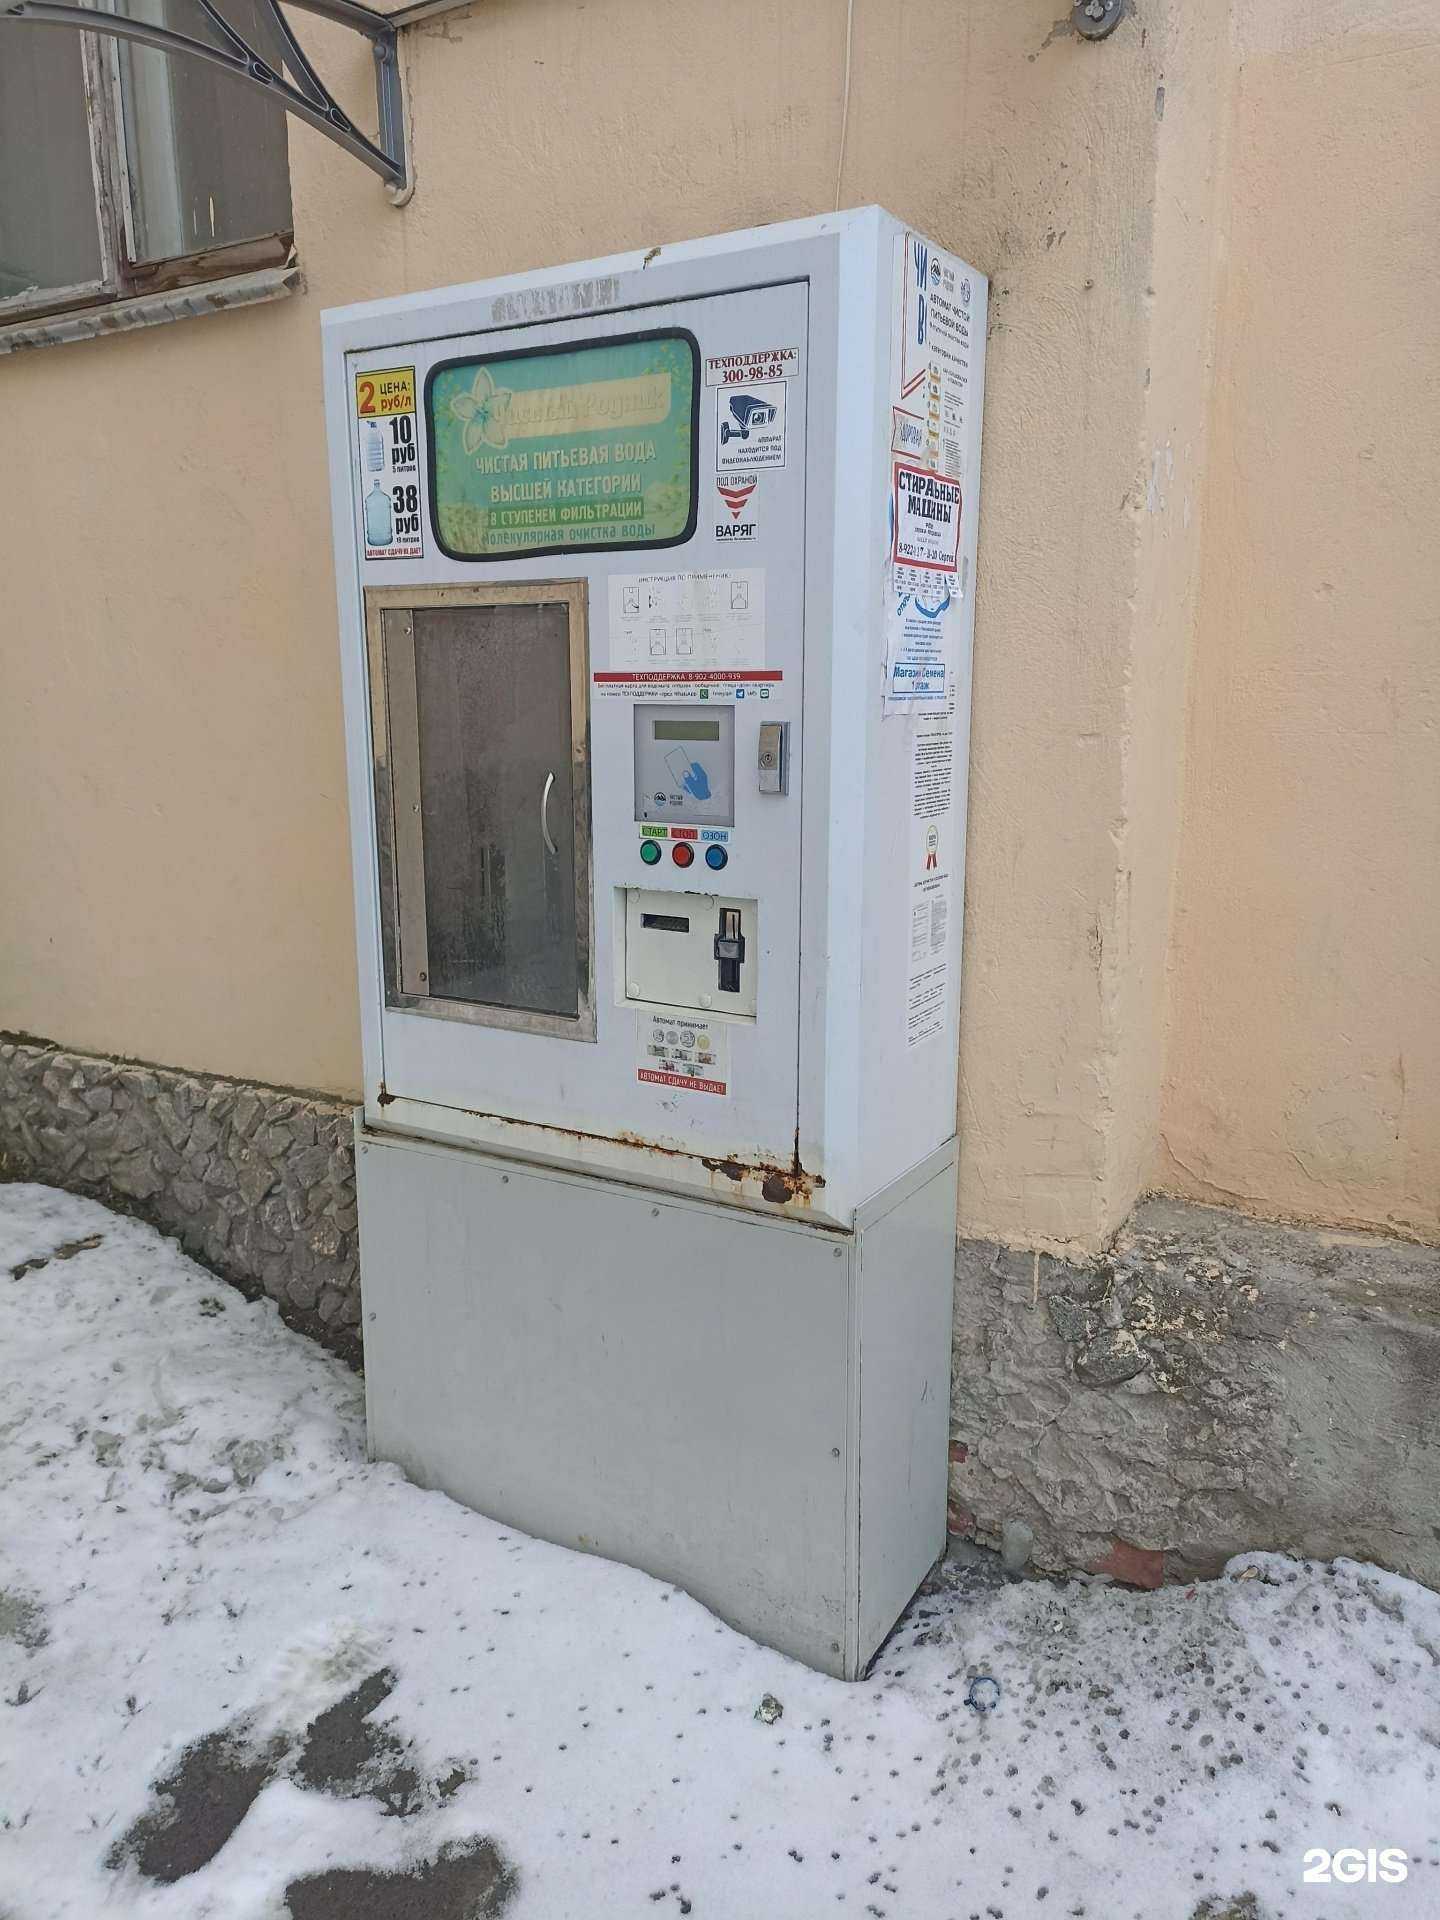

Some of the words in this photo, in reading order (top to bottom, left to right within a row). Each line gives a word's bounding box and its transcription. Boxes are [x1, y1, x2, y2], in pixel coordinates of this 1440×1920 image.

[930, 293, 951, 311] АВТОМАТ
[707, 350, 796, 370] ТЕХПОДДЕРЖКА:
[722, 364, 783, 383] 300-98-85
[359, 382, 376, 413] 2
[380, 381, 411, 396] ЦЕНА:
[381, 395, 411, 411] руб/л
[389, 415, 412, 444] 10
[391, 443, 416, 464] руб
[475, 453, 528, 474] ЧИСТАЯ
[533, 444, 609, 470] ПИТЬЕВАЯ
[615, 440, 656, 463] ВОДА
[491, 478, 552, 502] ВЫСШЕЙ
[558, 473, 641, 498] КАТЕГОРИИ
[717, 476, 728, 487] ПОД
[392, 485, 418, 513] 38
[907, 494, 951, 523] МАШИНЫ
[561, 500, 642, 521] ФИЛЬТРАЦИИ
[395, 514, 419, 534] руб
[569, 526, 616, 541] очистка
[622, 523, 655, 537] воды
[716, 524, 756, 537] ВАРЯГ
[702, 831, 728, 841] ОЗОН
[653, 1015, 676, 1026] Автомат
[640, 1072, 666, 1083] АВТОМАТ
[668, 1077, 687, 1087] СДАЧУ
[690, 1081, 697, 1089] НЕ
[699, 1082, 724, 1093] ВЫДАЕТ
